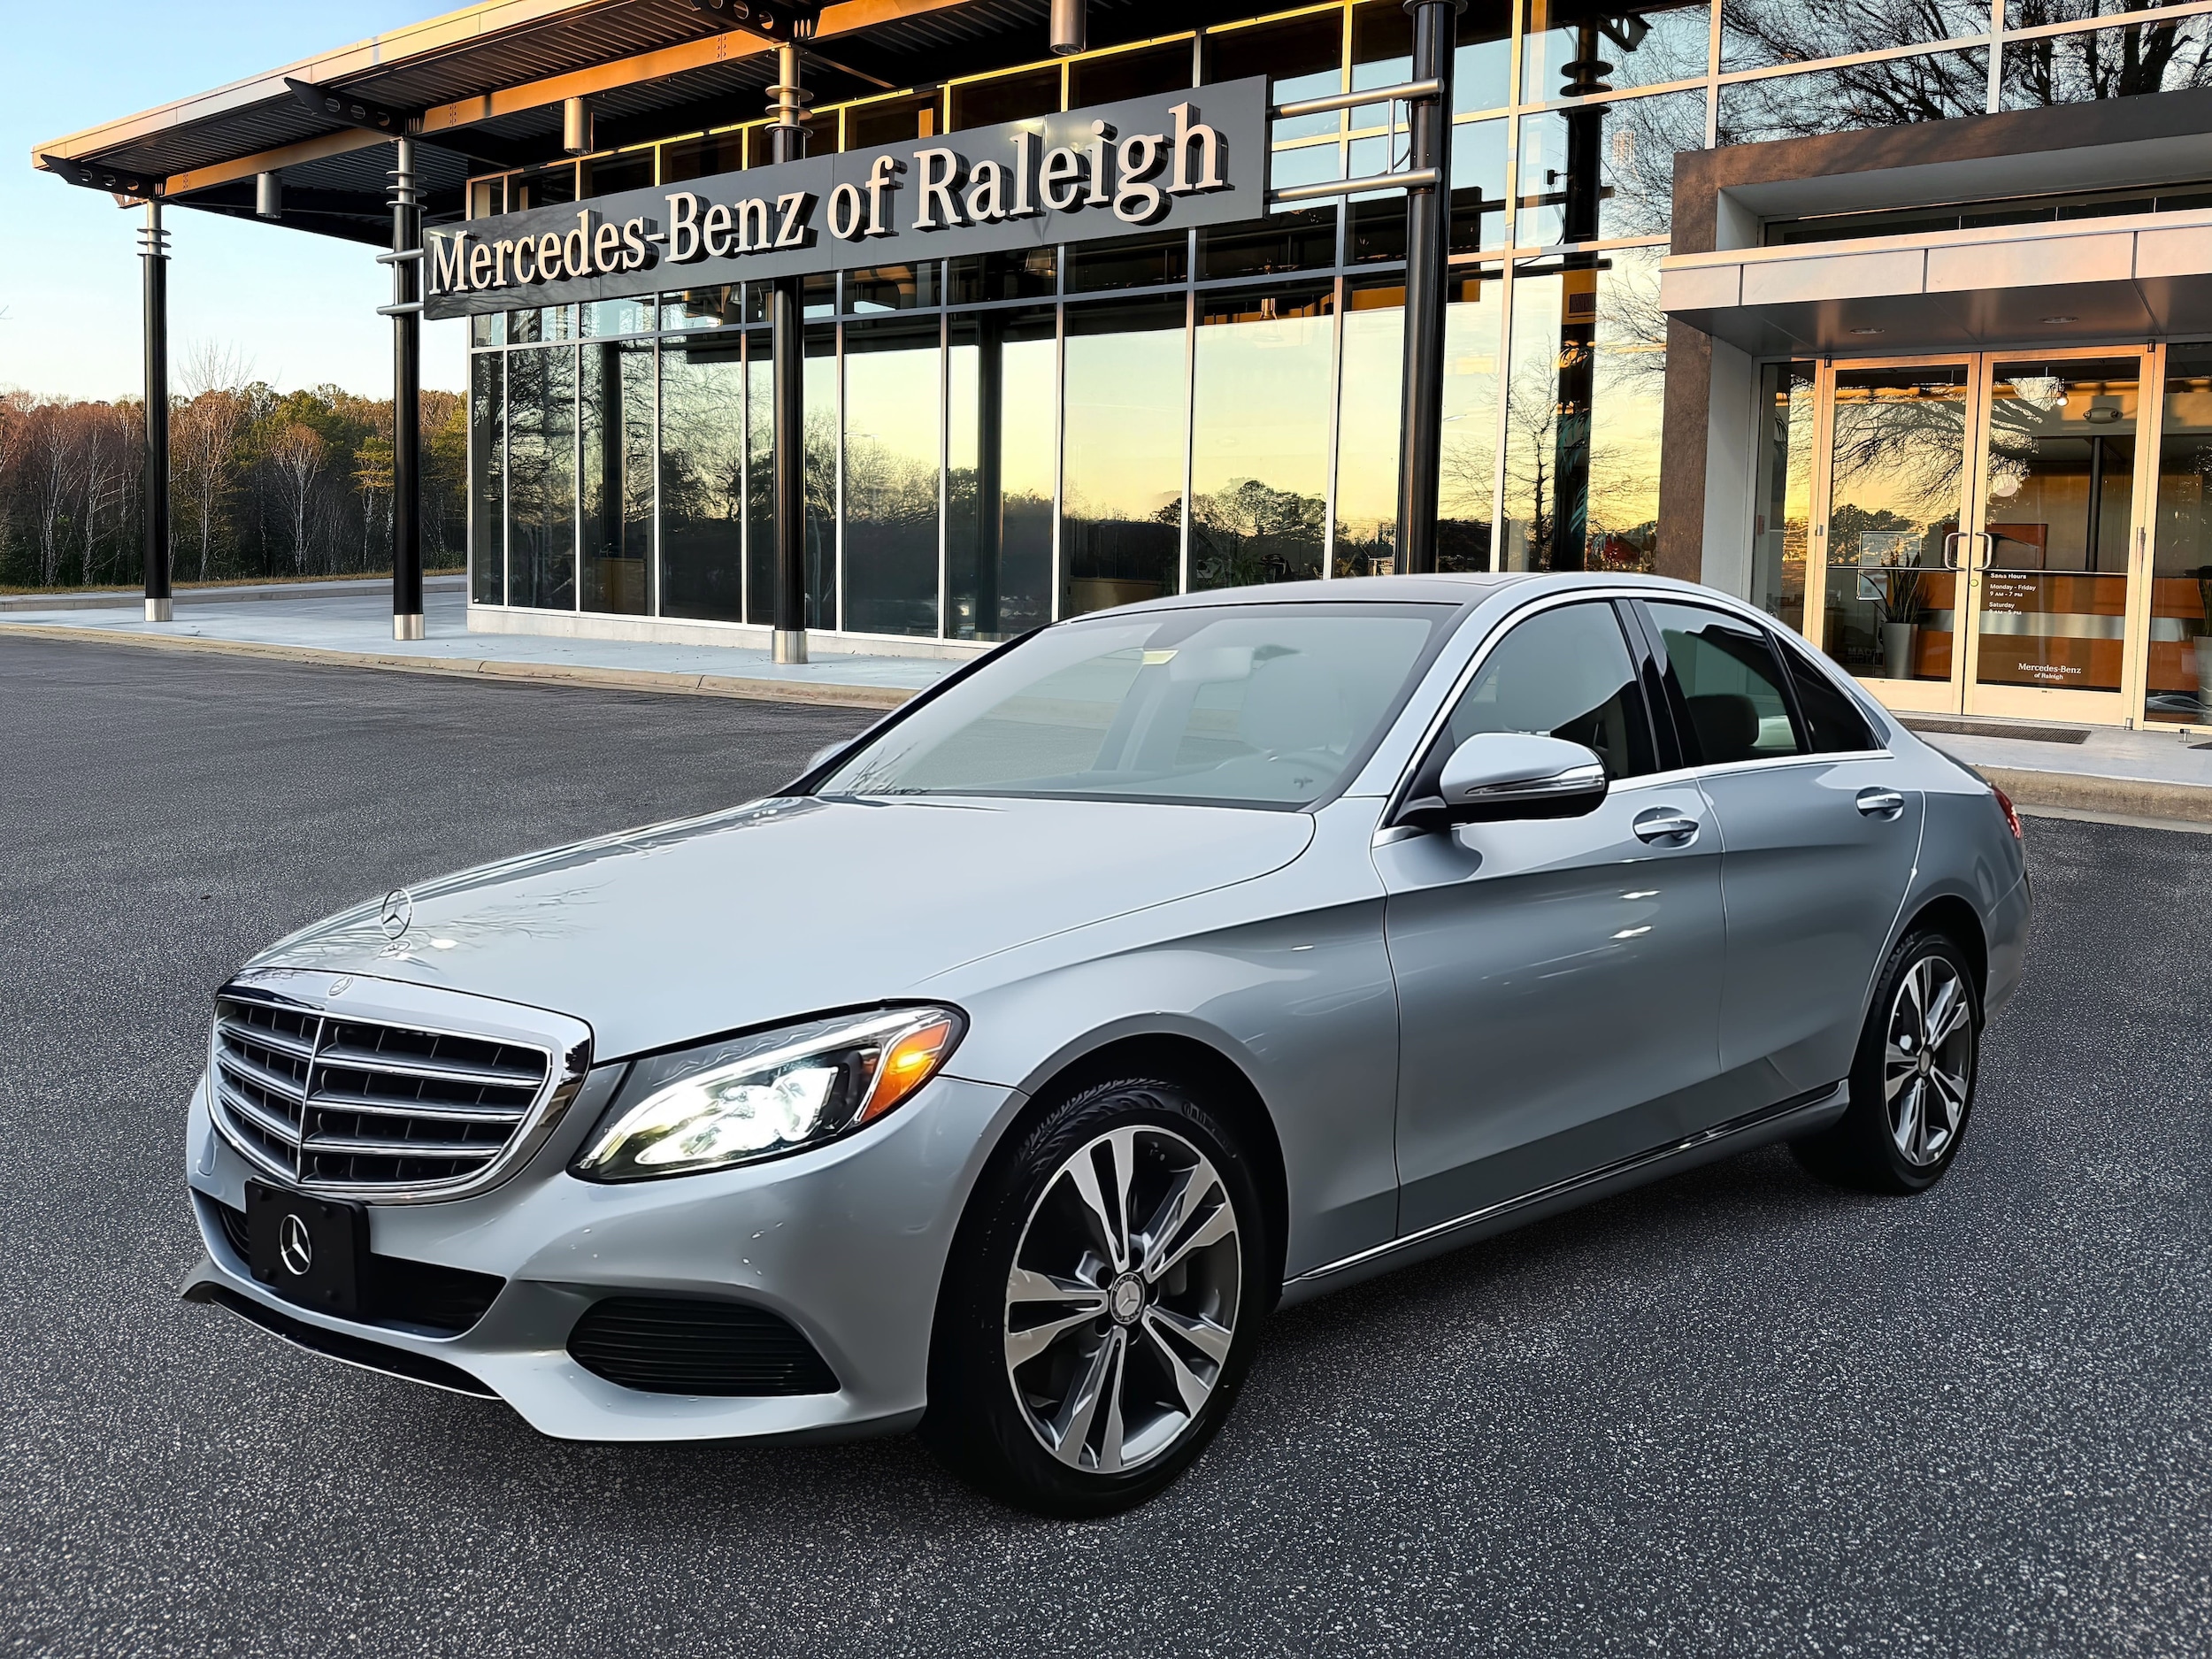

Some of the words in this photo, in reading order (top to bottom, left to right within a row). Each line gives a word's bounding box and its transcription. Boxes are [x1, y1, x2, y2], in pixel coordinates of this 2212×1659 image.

[428, 190, 807, 296] Mercedes-Benz
[827, 155, 895, 240] of
[912, 102, 1229, 231] Raleigh
[2018, 663, 2081, 673] Mercedes-Benz
